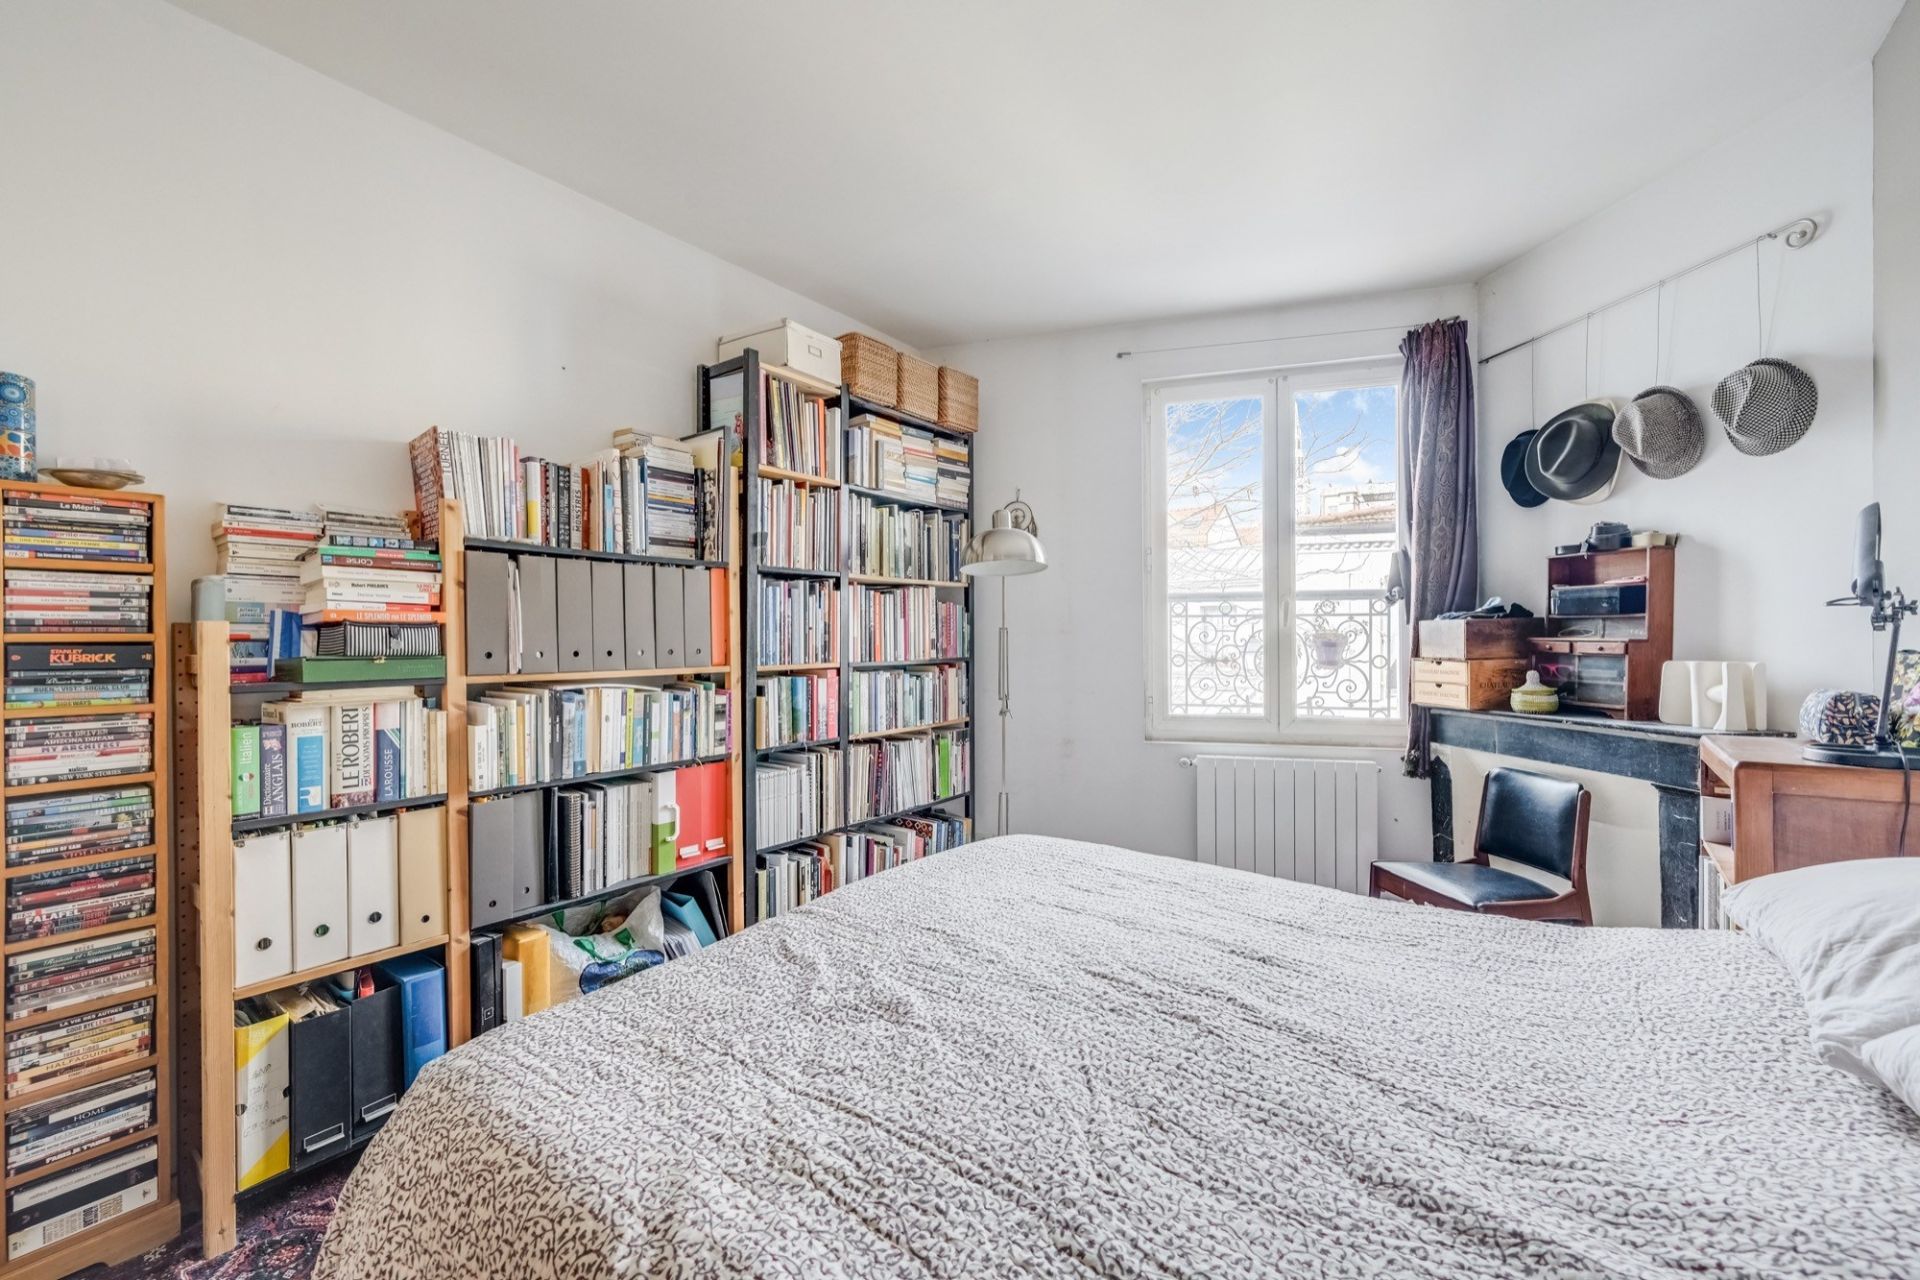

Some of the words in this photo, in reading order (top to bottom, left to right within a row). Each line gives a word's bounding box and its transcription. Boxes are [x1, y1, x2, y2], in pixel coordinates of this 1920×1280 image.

[439, 431, 451, 474] TURNER
[72, 504, 101, 512] Mépris
[574, 489, 582, 532] MONSTRES
[346, 557, 374, 567] Corse
[49, 653, 116, 663] KUBRICK
[291, 720, 323, 729] ROBERT
[48, 731, 73, 739] TAXI
[74, 728, 109, 737] DRIVER
[341, 706, 359, 768] ROBERT
[44, 737, 83, 746] ARIZONA
[61, 742, 120, 752] ARCHITECT
[240, 732, 254, 765] Italien
[272, 753, 284, 803] ANGLAIS
[342, 770, 359, 789] LE
[384, 748, 393, 797] LAROUSSE
[262, 763, 272, 807] Dictionnaire
[25, 909, 80, 924] FALAFEL
[97, 1007, 123, 1018] AUTRES
[66, 1026, 82, 1034] GOOD
[73, 1106, 106, 1122] HOME
